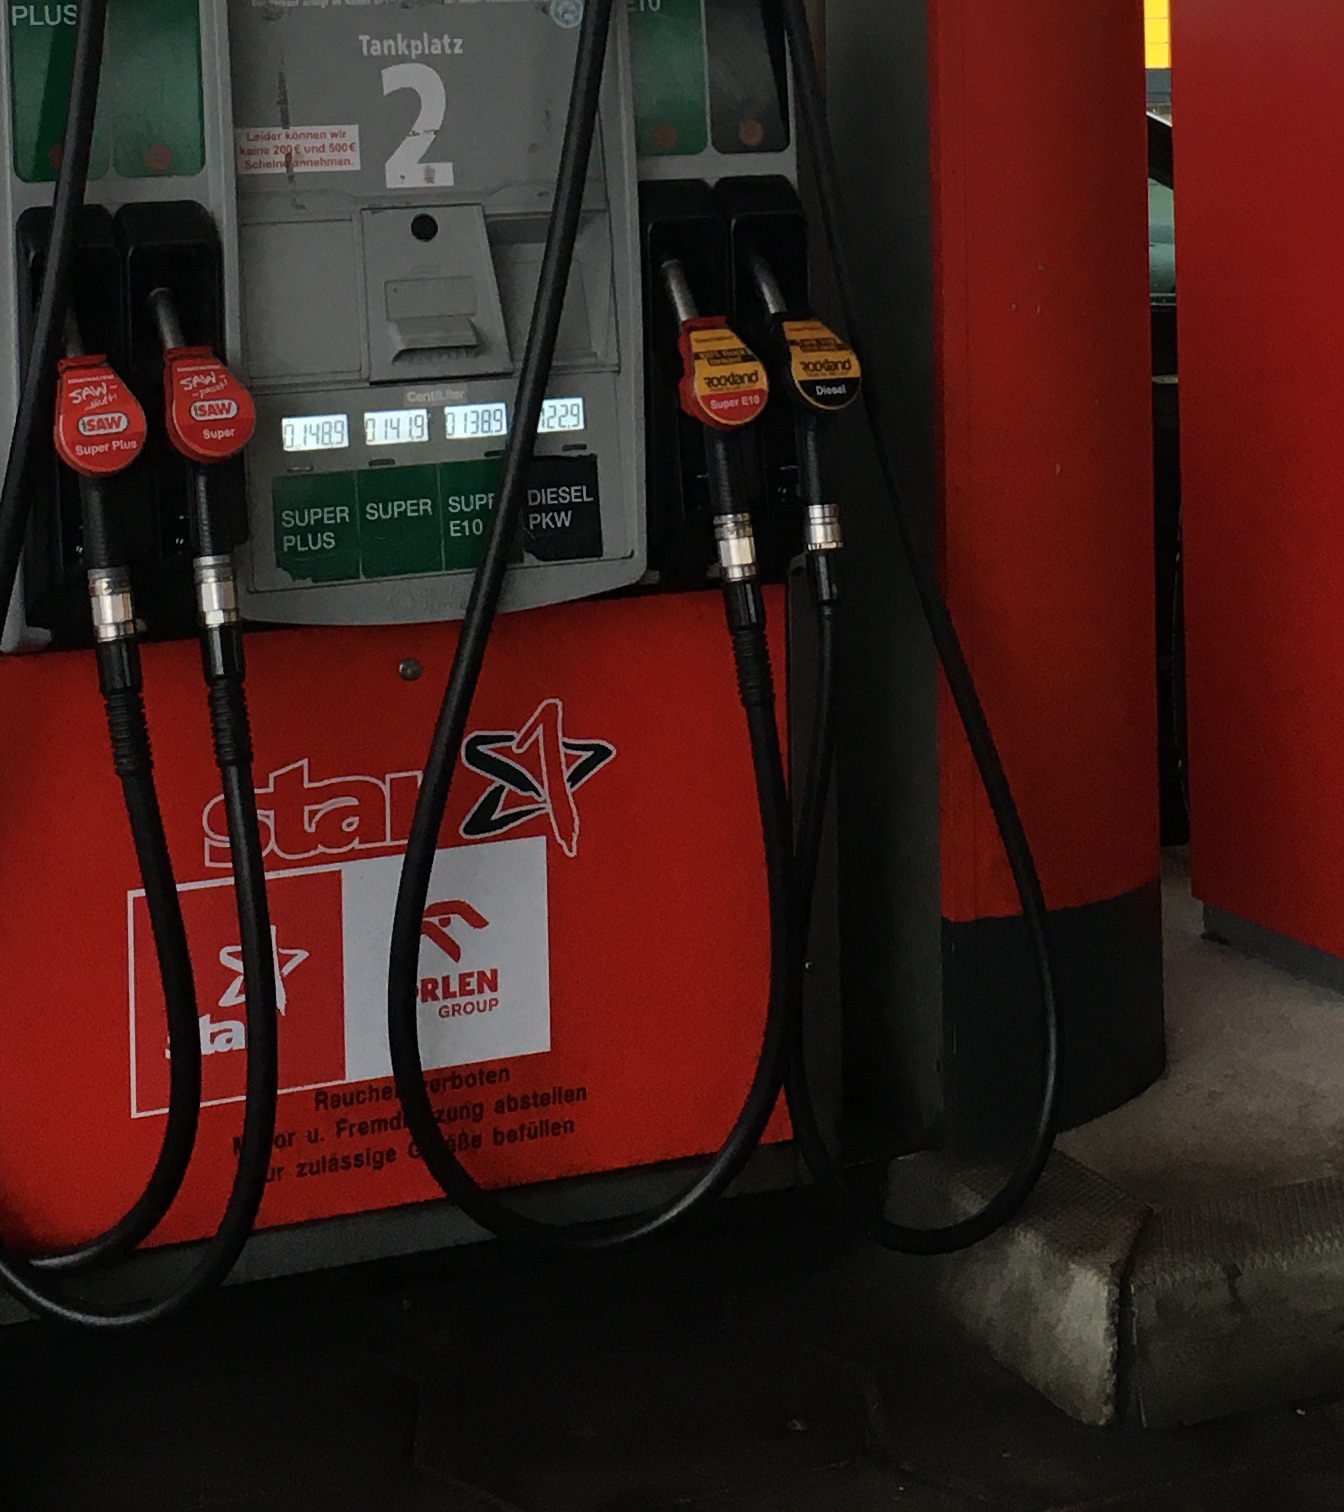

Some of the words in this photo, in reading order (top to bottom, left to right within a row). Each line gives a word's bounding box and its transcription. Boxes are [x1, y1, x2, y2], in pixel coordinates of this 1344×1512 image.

[11, 3, 79, 27] PLUS
[358, 32, 464, 59] Tankplatz
[246, 130, 282, 143] Leider
[285, 130, 327, 141] können
[329, 129, 348, 140] wir
[380, 63, 455, 189] 2
[239, 145, 270, 157] keine
[304, 143, 326, 154] und
[815, 384, 847, 396] Diesel
[709, 398, 740, 410] Super
[741, 395, 761, 406] E10
[202, 427, 236, 440] Super
[75, 444, 110, 457] Super
[111, 439, 138, 451] Plus
[527, 486, 594, 507] DIESEL
[281, 505, 350, 528] SUPER
[365, 498, 433, 521] SUPER
[528, 510, 573, 530] PKW
[449, 518, 484, 537] E10
[282, 531, 337, 552] PLUS
[415, 968, 499, 1003] RLEN
[438, 997, 500, 1019] GROUP
[164, 1013, 247, 1060] ta
[314, 1083, 398, 1112] Rauche
[425, 1067, 511, 1095] erboten
[306, 1126, 325, 1144] u.
[335, 1100, 484, 1140] Fremdzung
[493, 1086, 588, 1116] abstellen
[295, 1146, 398, 1177] zulässige
[492, 1117, 575, 1146] befüllen
